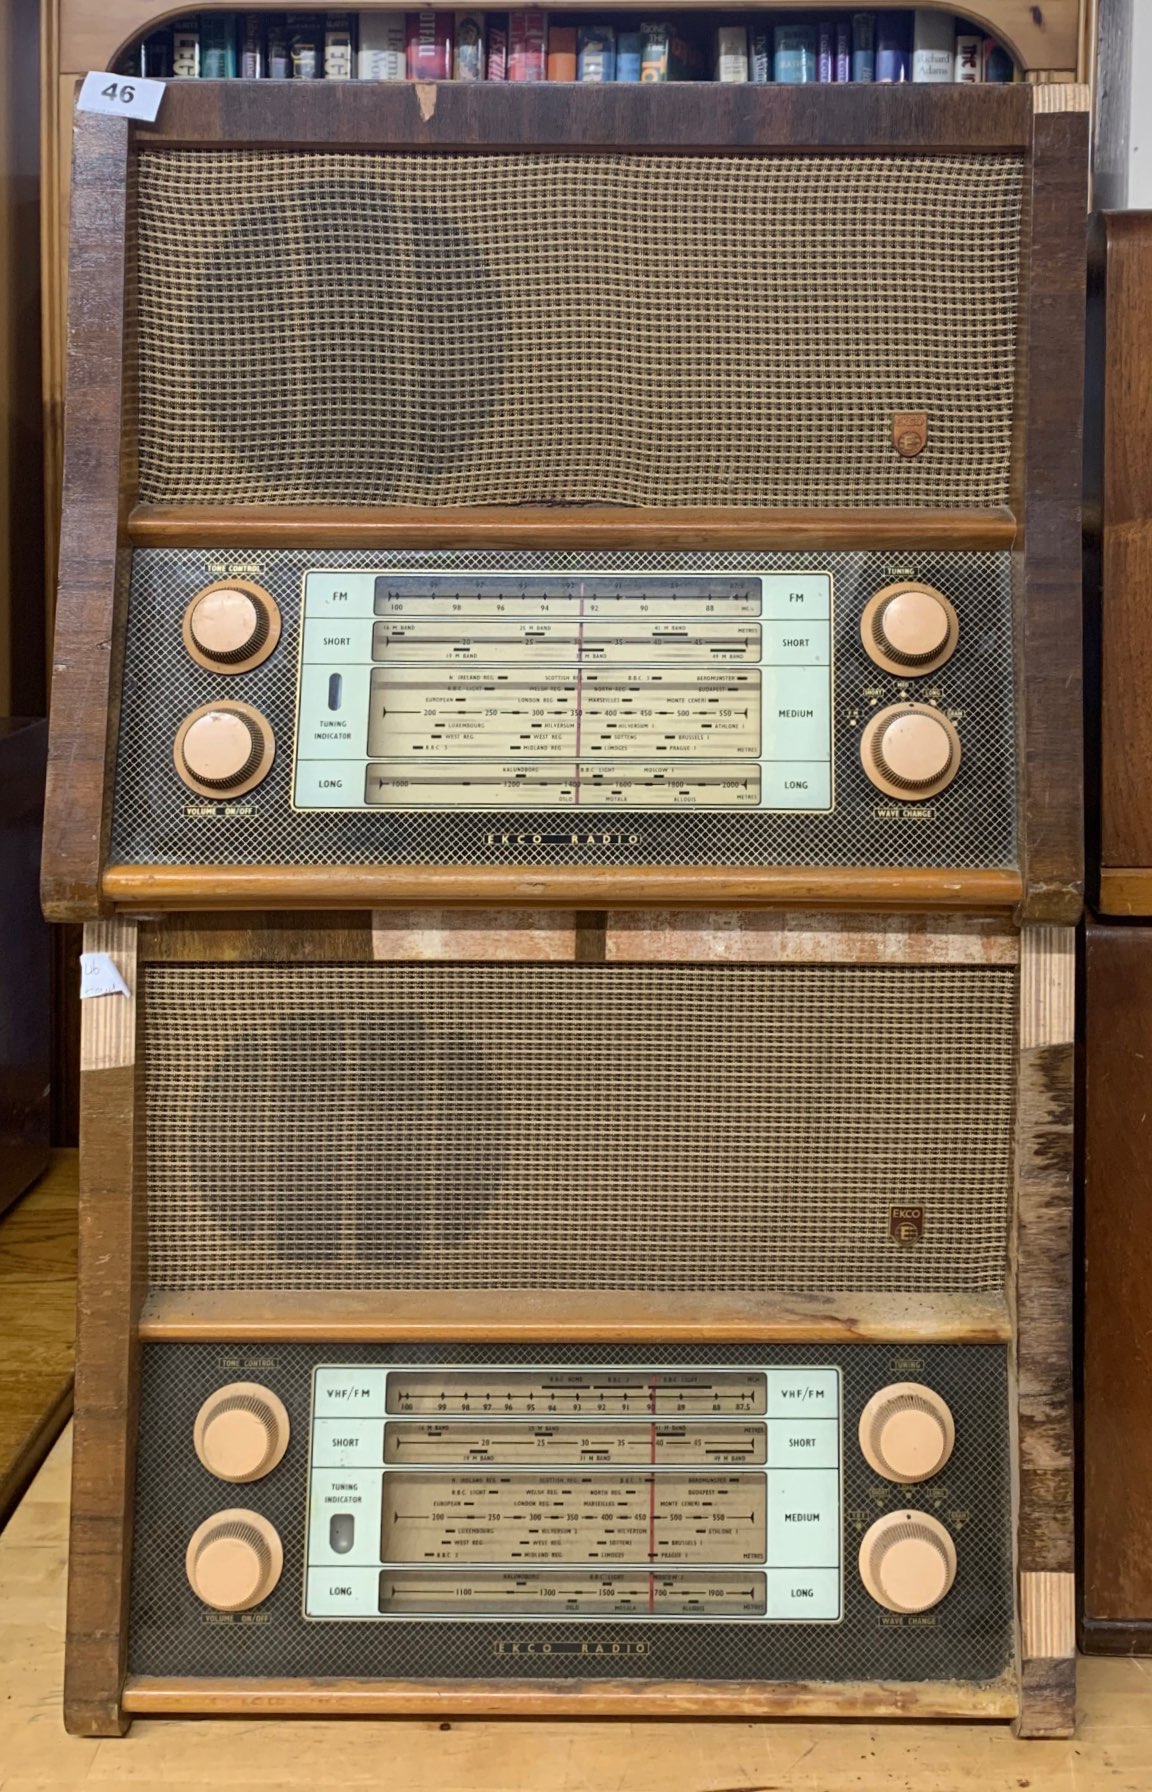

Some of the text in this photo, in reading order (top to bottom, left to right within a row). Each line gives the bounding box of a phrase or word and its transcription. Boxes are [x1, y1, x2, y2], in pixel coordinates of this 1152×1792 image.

[173, 40, 197, 77] LEG
[917, 54, 949, 63] Richard
[919, 66, 948, 74] Adams
[101, 83, 135, 103] 46
[333, 592, 348, 600] FM
[790, 594, 804, 602] FM
[782, 639, 810, 647] SHORT
[318, 780, 342, 788] LONG
[784, 781, 808, 789] LONG
[488, 834, 638, 844] EKCO RADIO
[893, 1209, 920, 1218] EKCO
[327, 1386, 370, 1400] VHF/FM
[781, 1386, 824, 1401] VHF/FM
[332, 1439, 359, 1447] SHORT
[789, 1439, 816, 1447] SHORT
[785, 1514, 820, 1522] MEDIUM
[791, 1589, 814, 1598] LONG
[499, 1644, 645, 1653] EKCO RADIO
